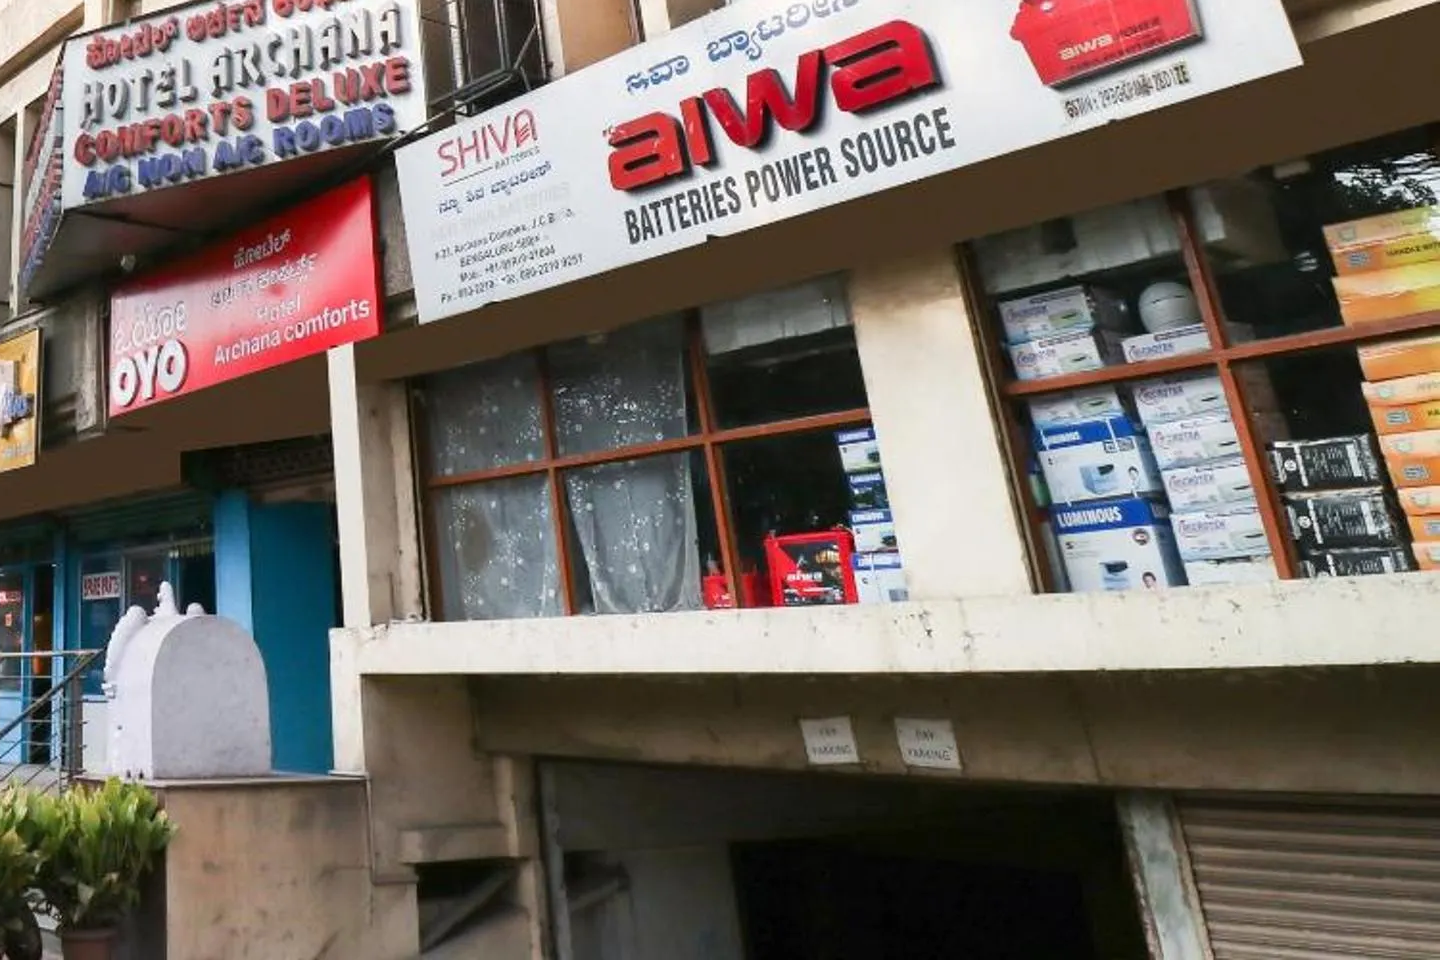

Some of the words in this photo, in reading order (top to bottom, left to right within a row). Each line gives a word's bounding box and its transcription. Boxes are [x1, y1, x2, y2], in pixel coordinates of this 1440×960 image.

[81, 57, 197, 130] HOTEL
[211, 0, 402, 97] ARCHANA
[74, 96, 254, 166] COMFORTS
[265, 56, 410, 123] DELUXE
[137, 146, 207, 188] NON
[273, 103, 396, 159] ROOMS
[437, 108, 538, 177] SHIVA
[624, 175, 742, 246] BATTERIES
[745, 145, 838, 209] POWER
[839, 106, 957, 178] SOURCE
[110, 339, 188, 407] OYO
[213, 330, 281, 366] Archana
[1057, 505, 1122, 529] LUMINOUS
